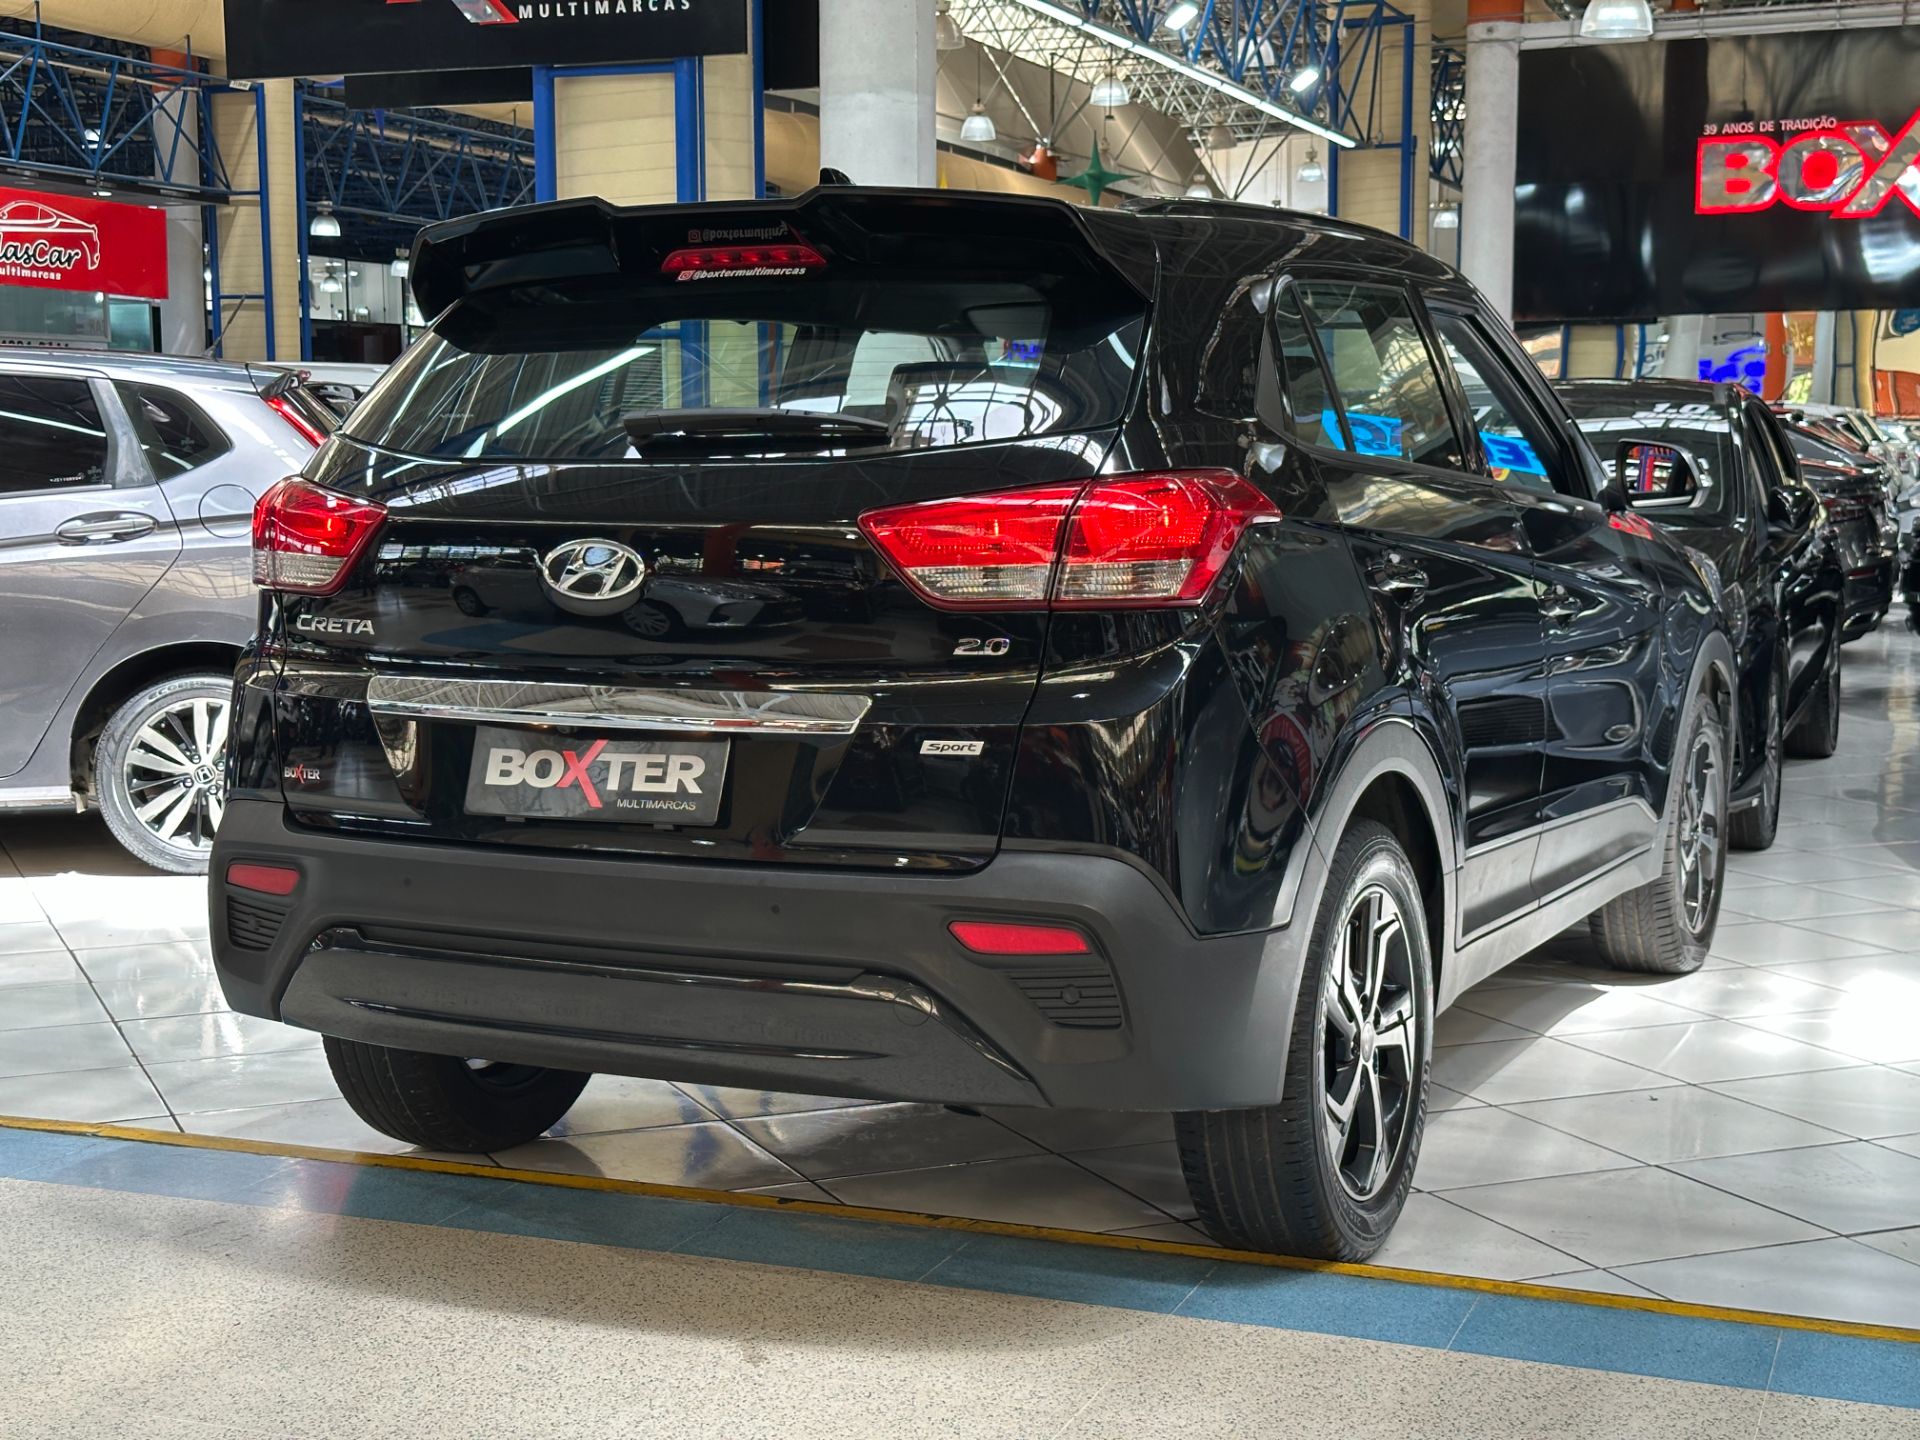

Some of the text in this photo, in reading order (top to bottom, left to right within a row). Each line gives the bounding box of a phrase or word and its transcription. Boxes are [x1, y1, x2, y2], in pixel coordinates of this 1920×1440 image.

[518, 0, 691, 19] MULTIMARCAS
[1703, 115, 1838, 136] 39 ANOS DE TRADIÇÃO
[296, 614, 375, 635] CRETA
[953, 637, 1010, 656] 2.0
[926, 742, 978, 753] Sport
[284, 763, 321, 784] BOXTER
[484, 738, 706, 809] BOXTER
[616, 798, 697, 811] MULTIMARCAS
